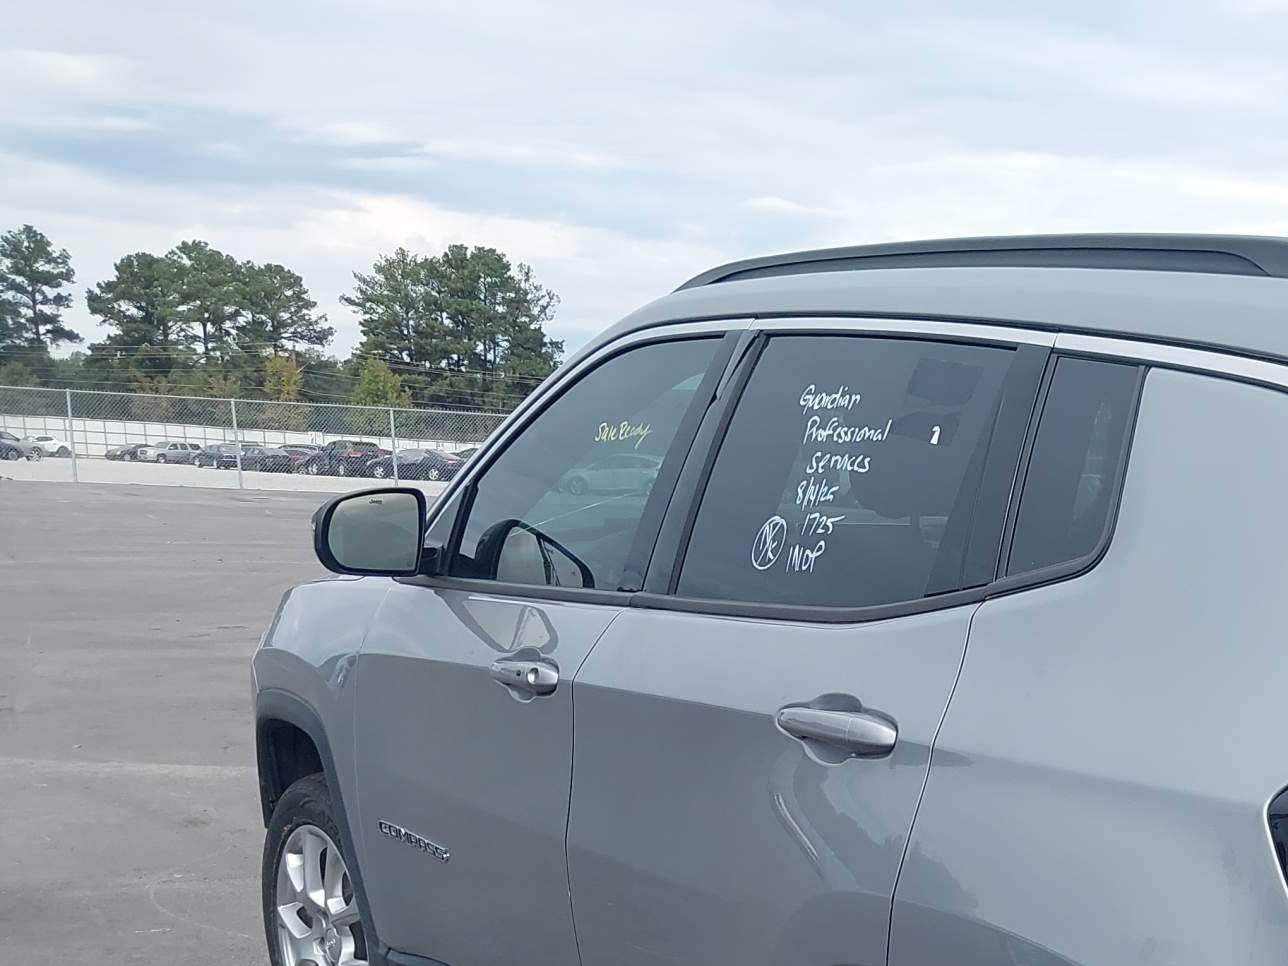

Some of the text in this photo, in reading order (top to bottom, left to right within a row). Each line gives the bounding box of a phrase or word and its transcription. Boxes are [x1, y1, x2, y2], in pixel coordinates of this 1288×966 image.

[803, 415, 892, 444] Professional
[801, 512, 846, 536] 1725
[379, 820, 450, 863] COMPASS
